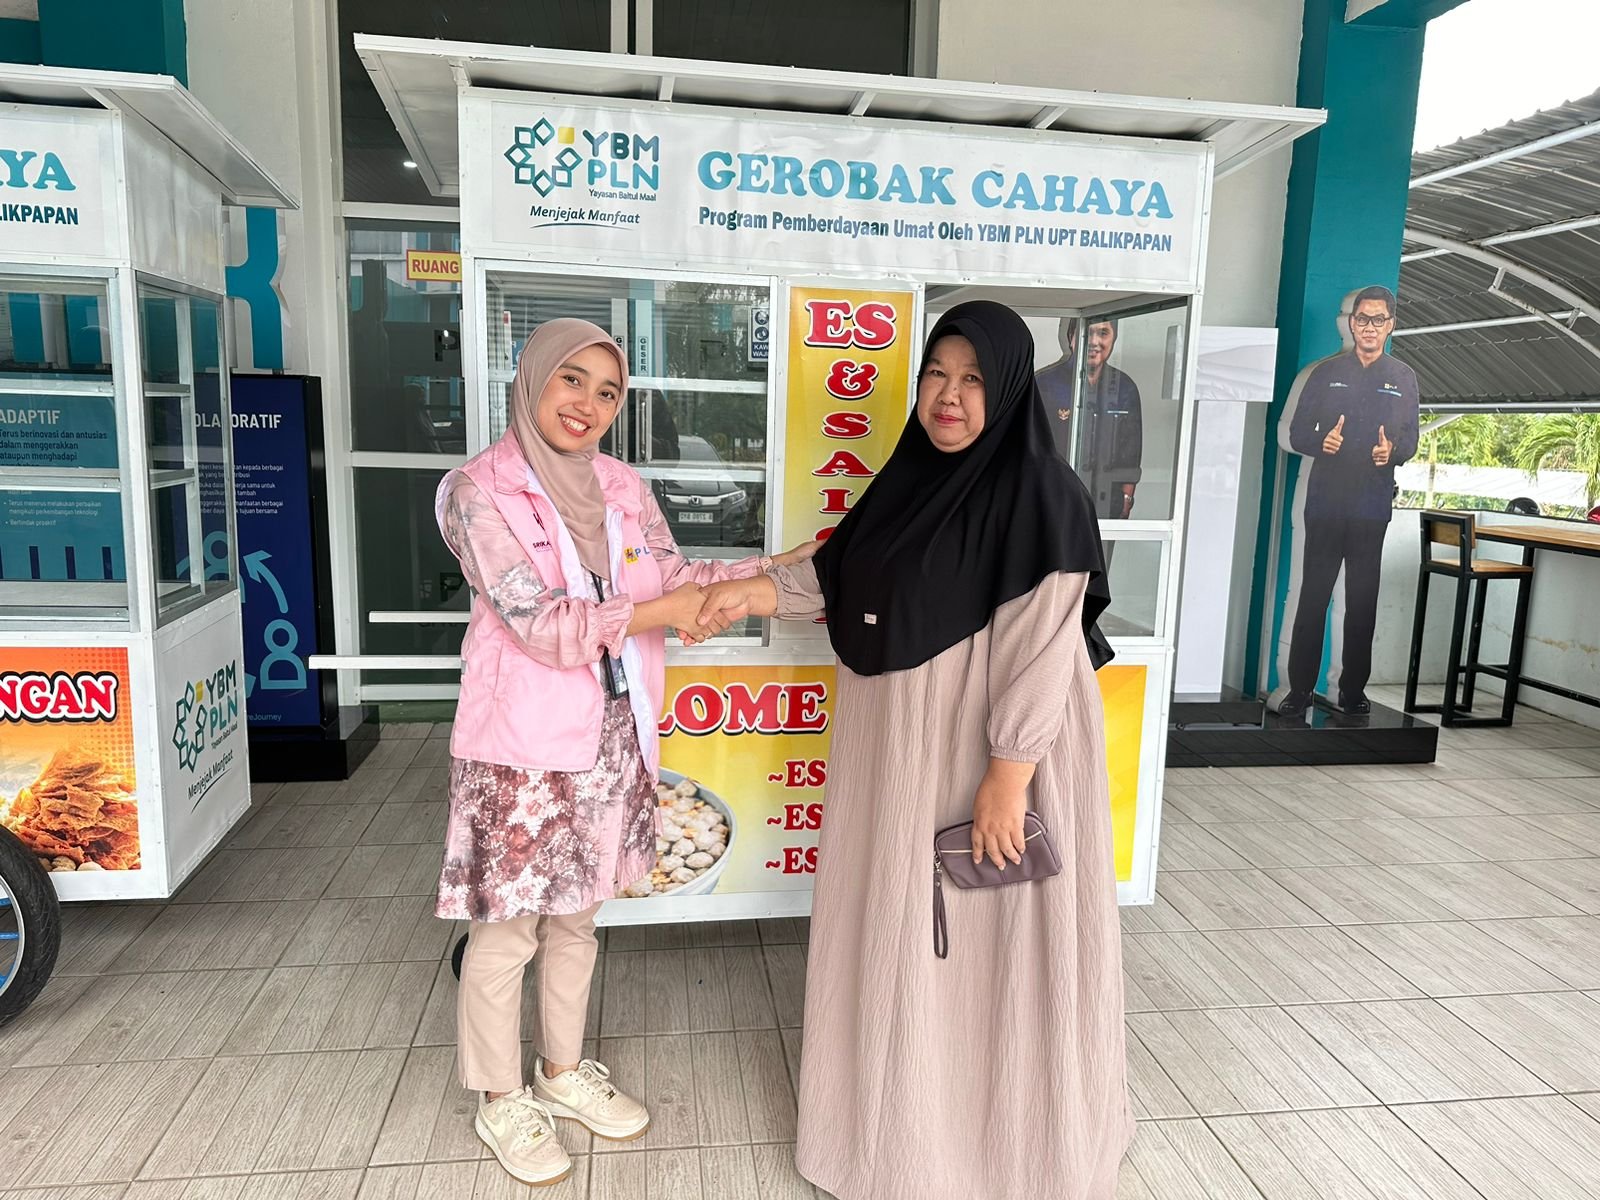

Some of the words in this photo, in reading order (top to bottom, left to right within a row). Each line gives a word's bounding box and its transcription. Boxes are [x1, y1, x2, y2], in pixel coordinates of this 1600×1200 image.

[582, 129, 660, 162] YBM
[0, 150, 76, 191] YA
[587, 160, 660, 191] PLN
[589, 189, 618, 201] Yayasan
[698, 150, 957, 206] GEROBAK
[971, 170, 1175, 219] CAHAYA
[529, 205, 585, 222] Menjejak
[587, 209, 641, 225] Manfaat
[699, 206, 768, 231] Program
[772, 210, 889, 239] Pemberdayaan
[893, 219, 935, 239] Umat
[938, 221, 974, 241] Oleh
[977, 223, 1011, 243] YBM
[1015, 225, 1044, 245] PLN
[1048, 227, 1077, 247] UPT
[1079, 230, 1172, 252] BALIKPAPAN
[412, 258, 459, 274] RUANG
[804, 299, 897, 349] ES
[825, 359, 879, 400] &
[0, 409, 61, 425] ADAPTIF
[195, 413, 282, 428] OLAORATIF
[20, 429, 60, 439] berinovasi
[60, 430, 75, 439] dan
[23, 441, 79, 451] menggerakkan
[32, 452, 78, 462] menghadapi
[261, 464, 284, 472] berbagai
[205, 659, 237, 705] YBM
[209, 690, 238, 737] PLN
